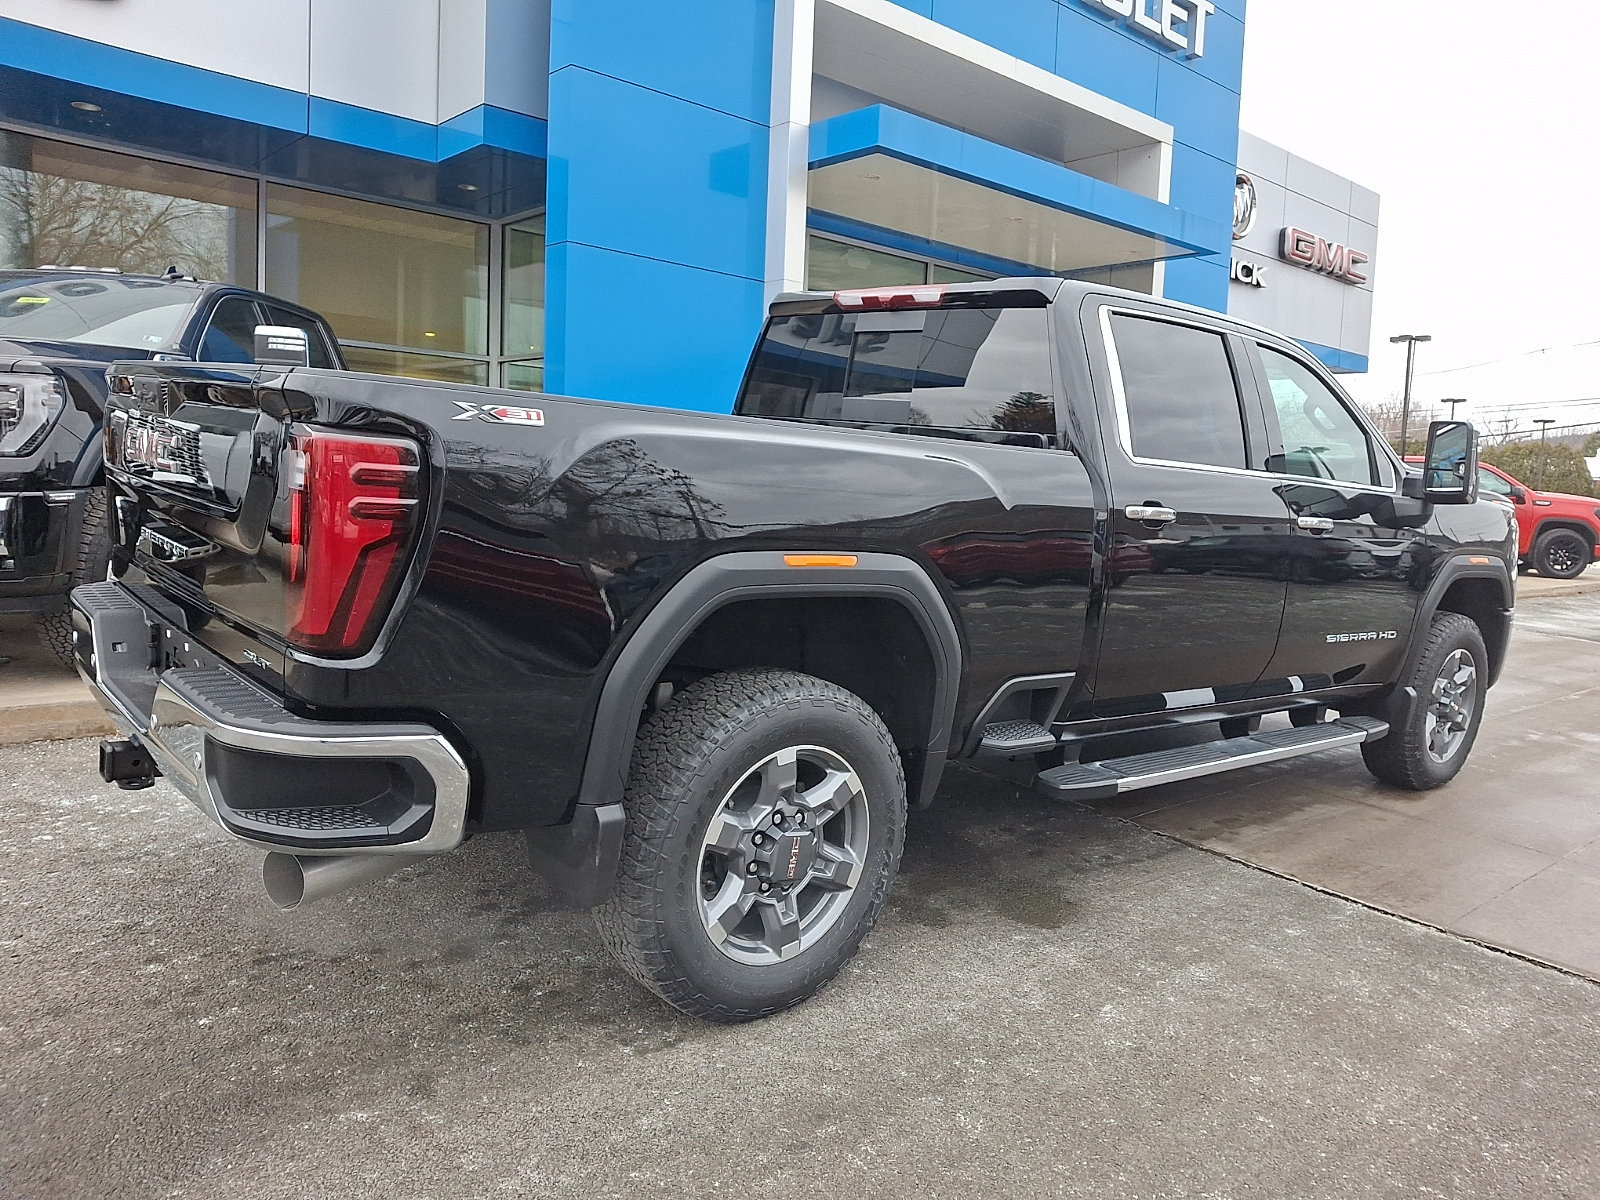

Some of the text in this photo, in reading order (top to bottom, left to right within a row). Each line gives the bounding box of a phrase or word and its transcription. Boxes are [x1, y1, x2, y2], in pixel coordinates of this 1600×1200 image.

[1284, 226, 1369, 285] GMC
[1326, 630, 1397, 643] SIERRA HD
[787, 836, 801, 879] GMC
